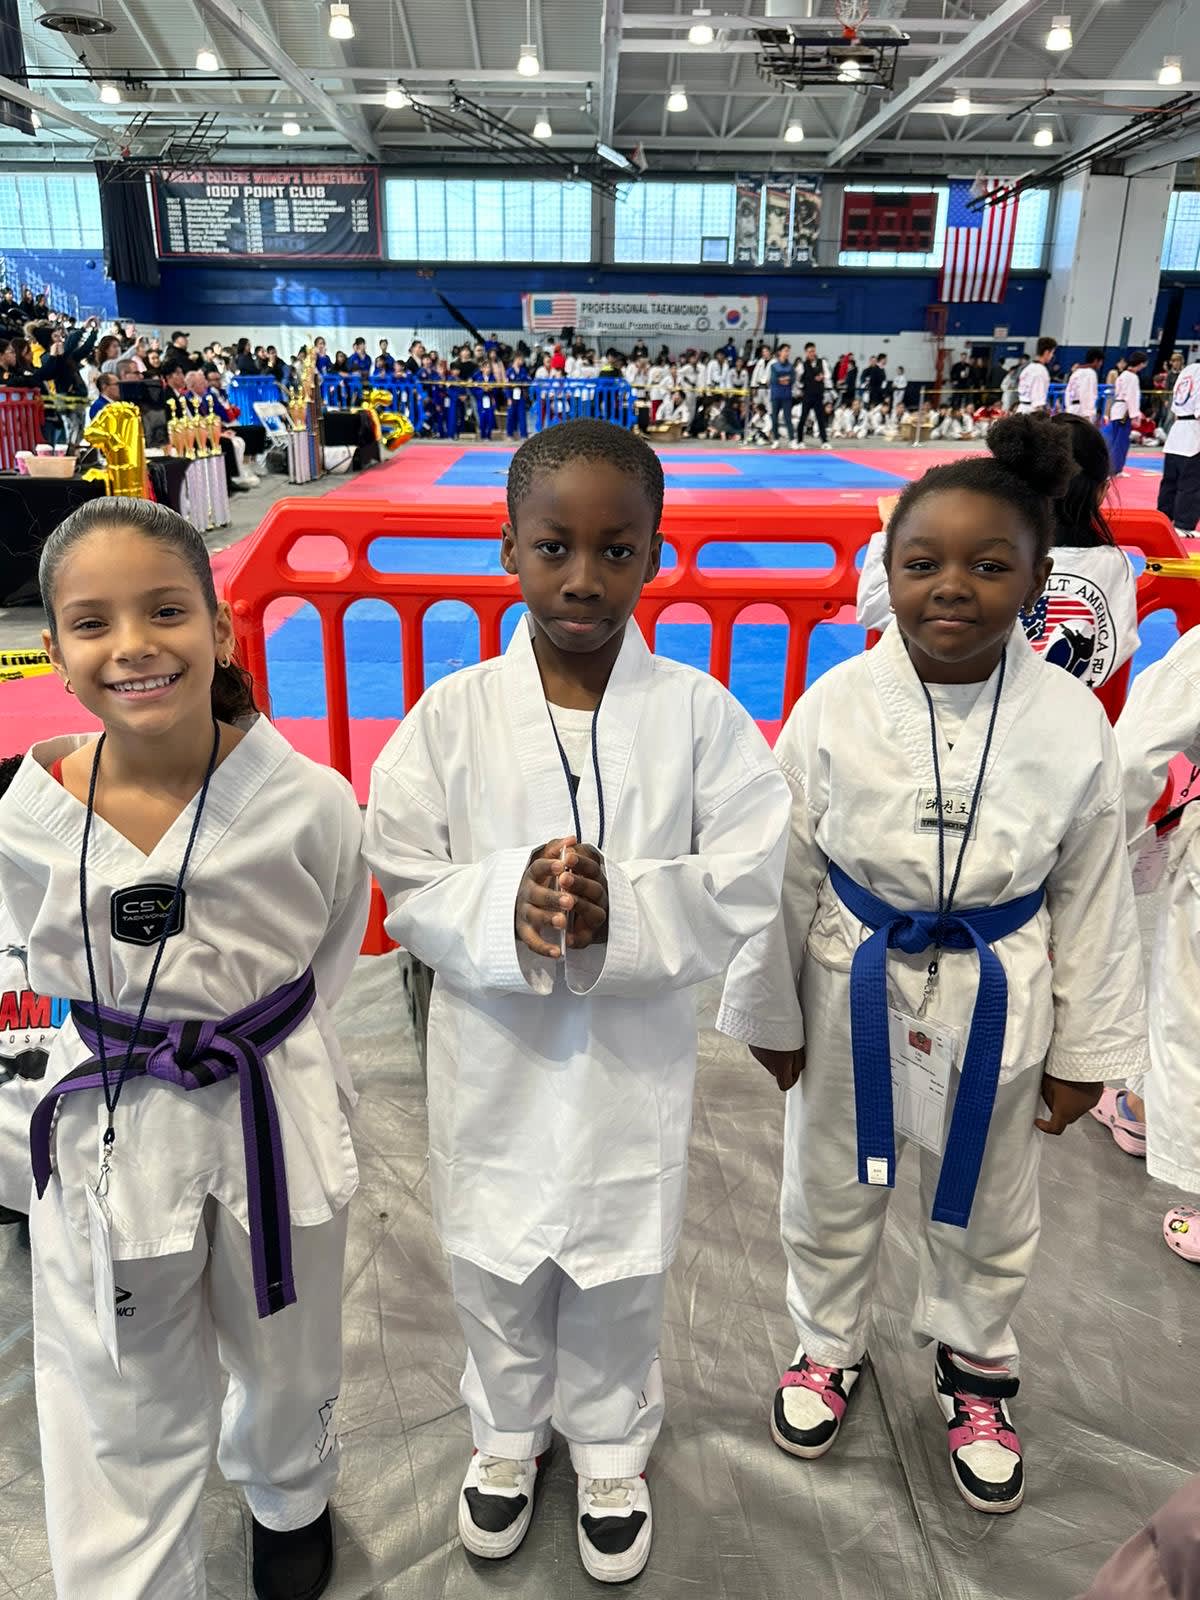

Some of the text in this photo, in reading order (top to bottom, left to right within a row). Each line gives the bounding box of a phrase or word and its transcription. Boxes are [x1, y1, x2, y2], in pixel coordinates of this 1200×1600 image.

[302, 172, 367, 185] BASKETBALL
[206, 186, 326, 198] 1000 POINT CLUB
[580, 302, 649, 314] PROFESSIONAL
[629, 320, 671, 330] Promotion
[1047, 578, 1111, 654] LT AMERICA
[122, 900, 175, 914] CSV
